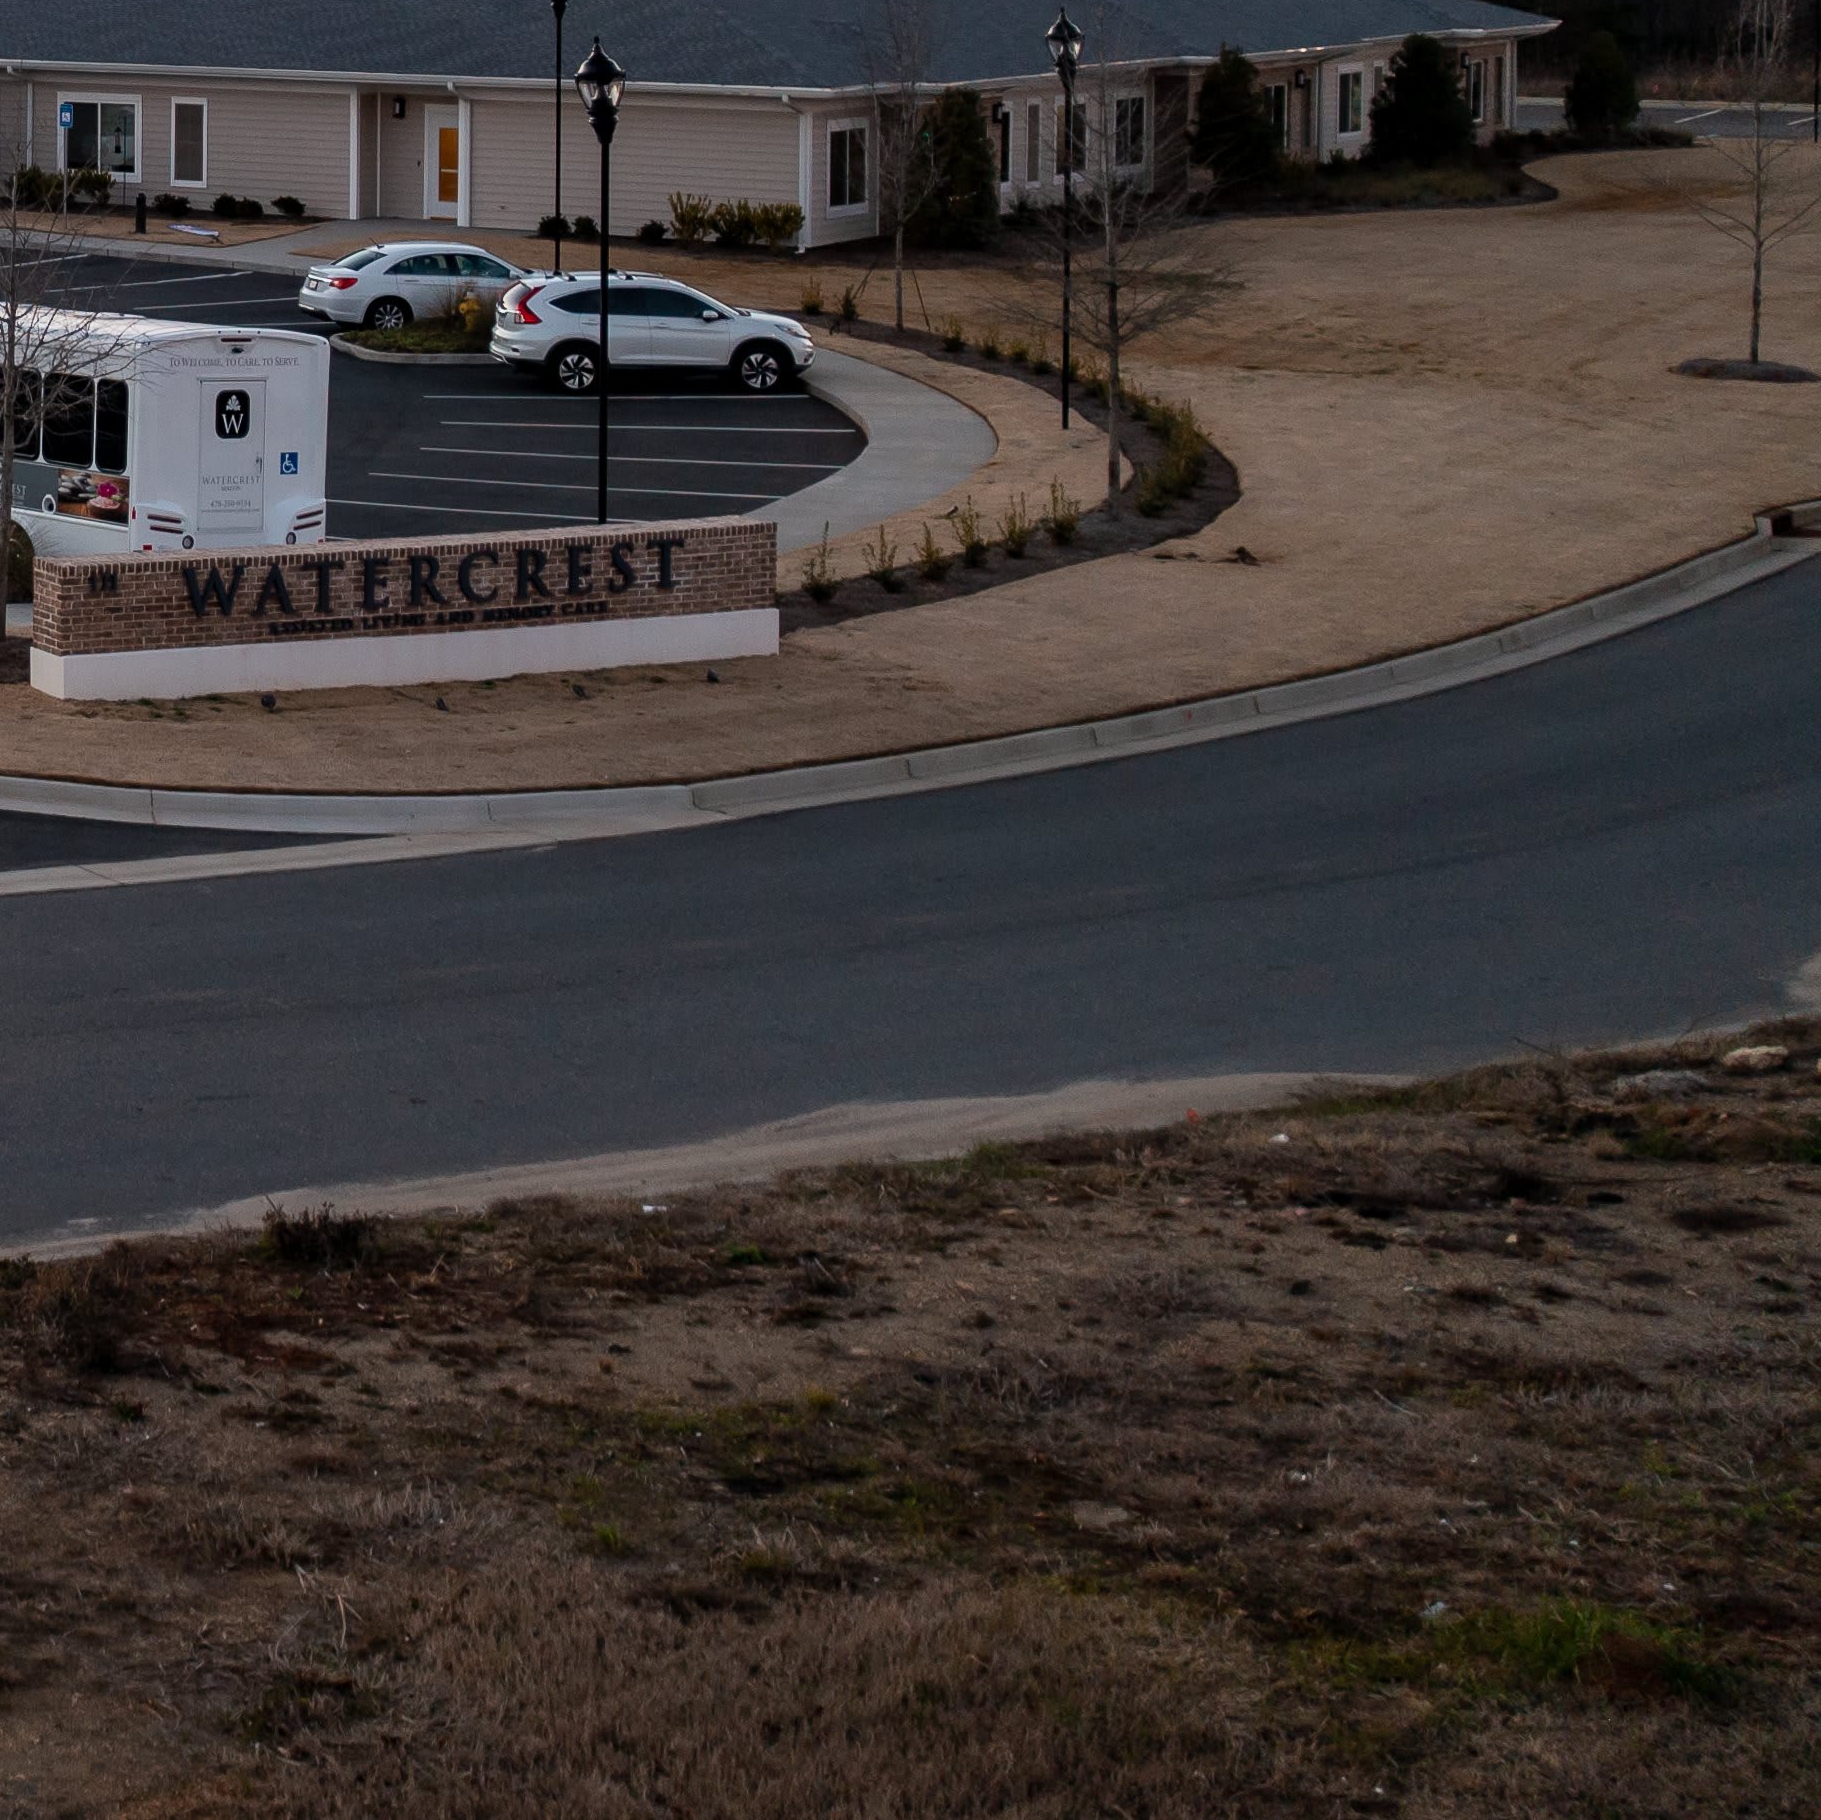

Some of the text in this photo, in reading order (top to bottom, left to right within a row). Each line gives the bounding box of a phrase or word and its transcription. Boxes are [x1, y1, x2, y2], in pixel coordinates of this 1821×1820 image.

[221, 413, 244, 434] W
[202, 475, 261, 485] WATERCREST
[182, 538, 685, 617] WATERCREST
[268, 600, 609, 634] ASSISTED LIVING AND MEMORY CARE
